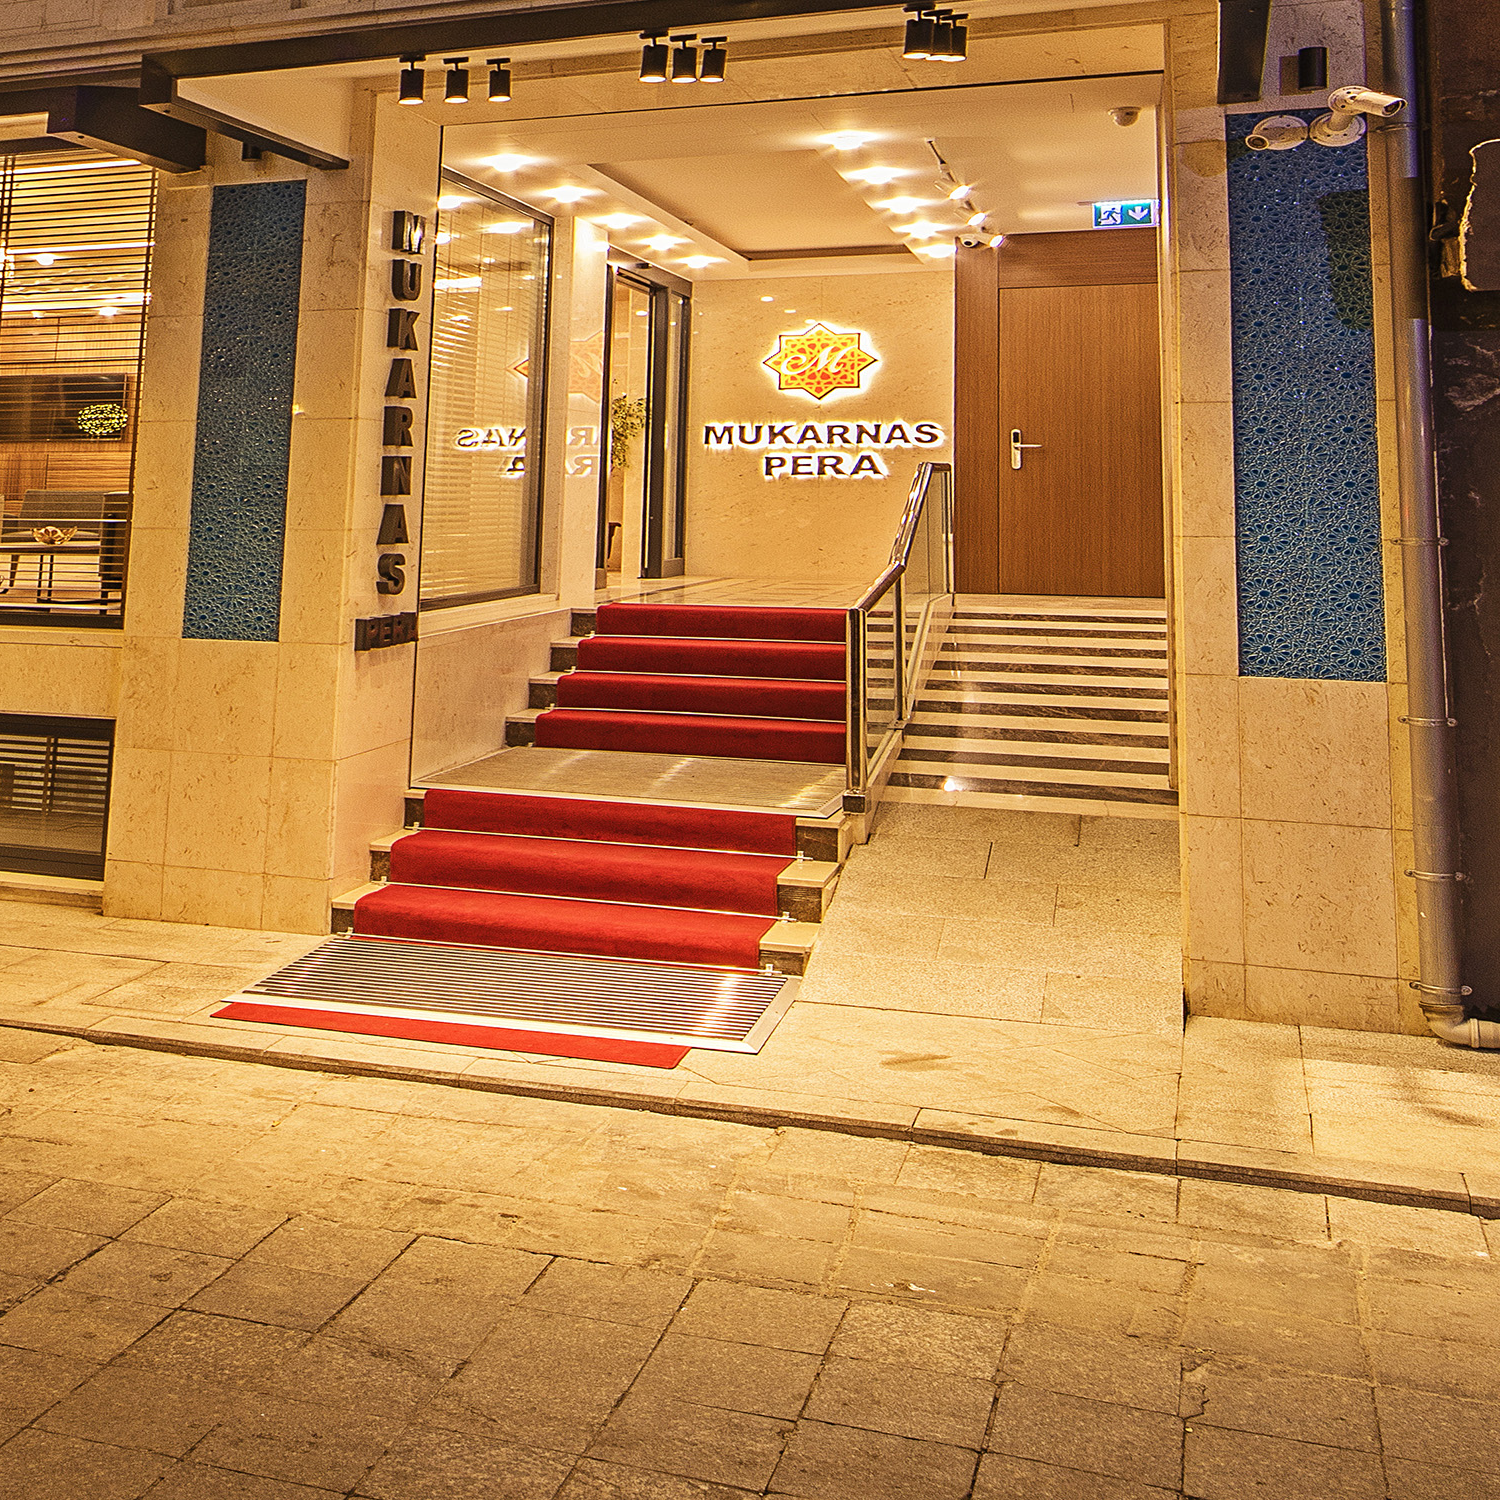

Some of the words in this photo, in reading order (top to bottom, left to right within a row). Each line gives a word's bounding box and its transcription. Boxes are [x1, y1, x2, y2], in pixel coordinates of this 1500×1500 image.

[375, 209, 427, 596] MUKARNAS
[703, 422, 942, 446] MUKARNAS
[763, 454, 885, 477] PERA
[354, 611, 420, 652] PERA
